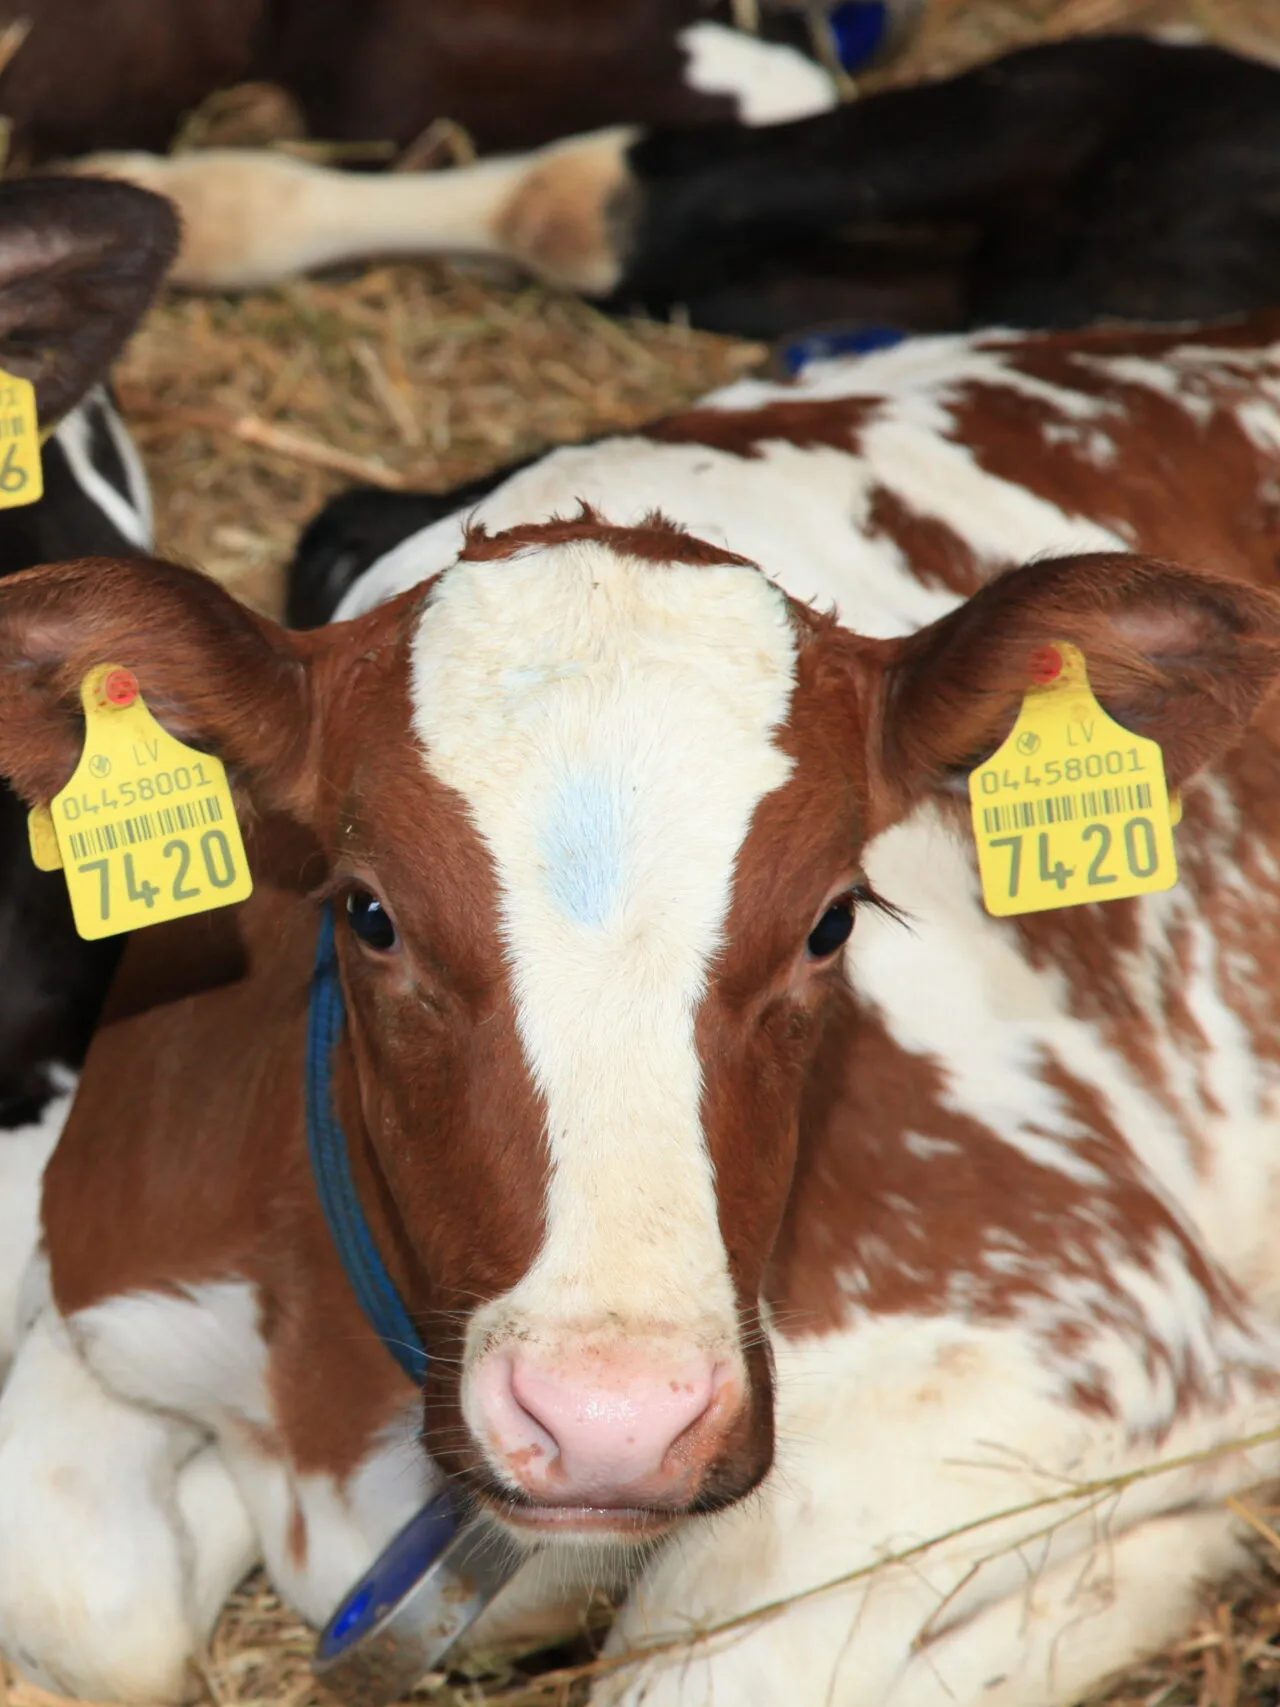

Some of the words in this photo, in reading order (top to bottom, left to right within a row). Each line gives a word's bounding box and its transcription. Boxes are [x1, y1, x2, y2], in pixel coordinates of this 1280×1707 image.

[133, 738, 159, 767] LV
[1066, 720, 1095, 747] LV
[62, 762, 212, 821] 04458001
[981, 748, 1145, 795] 04458001
[78, 829, 237, 921] 7420
[988, 816, 1159, 898] 7420
